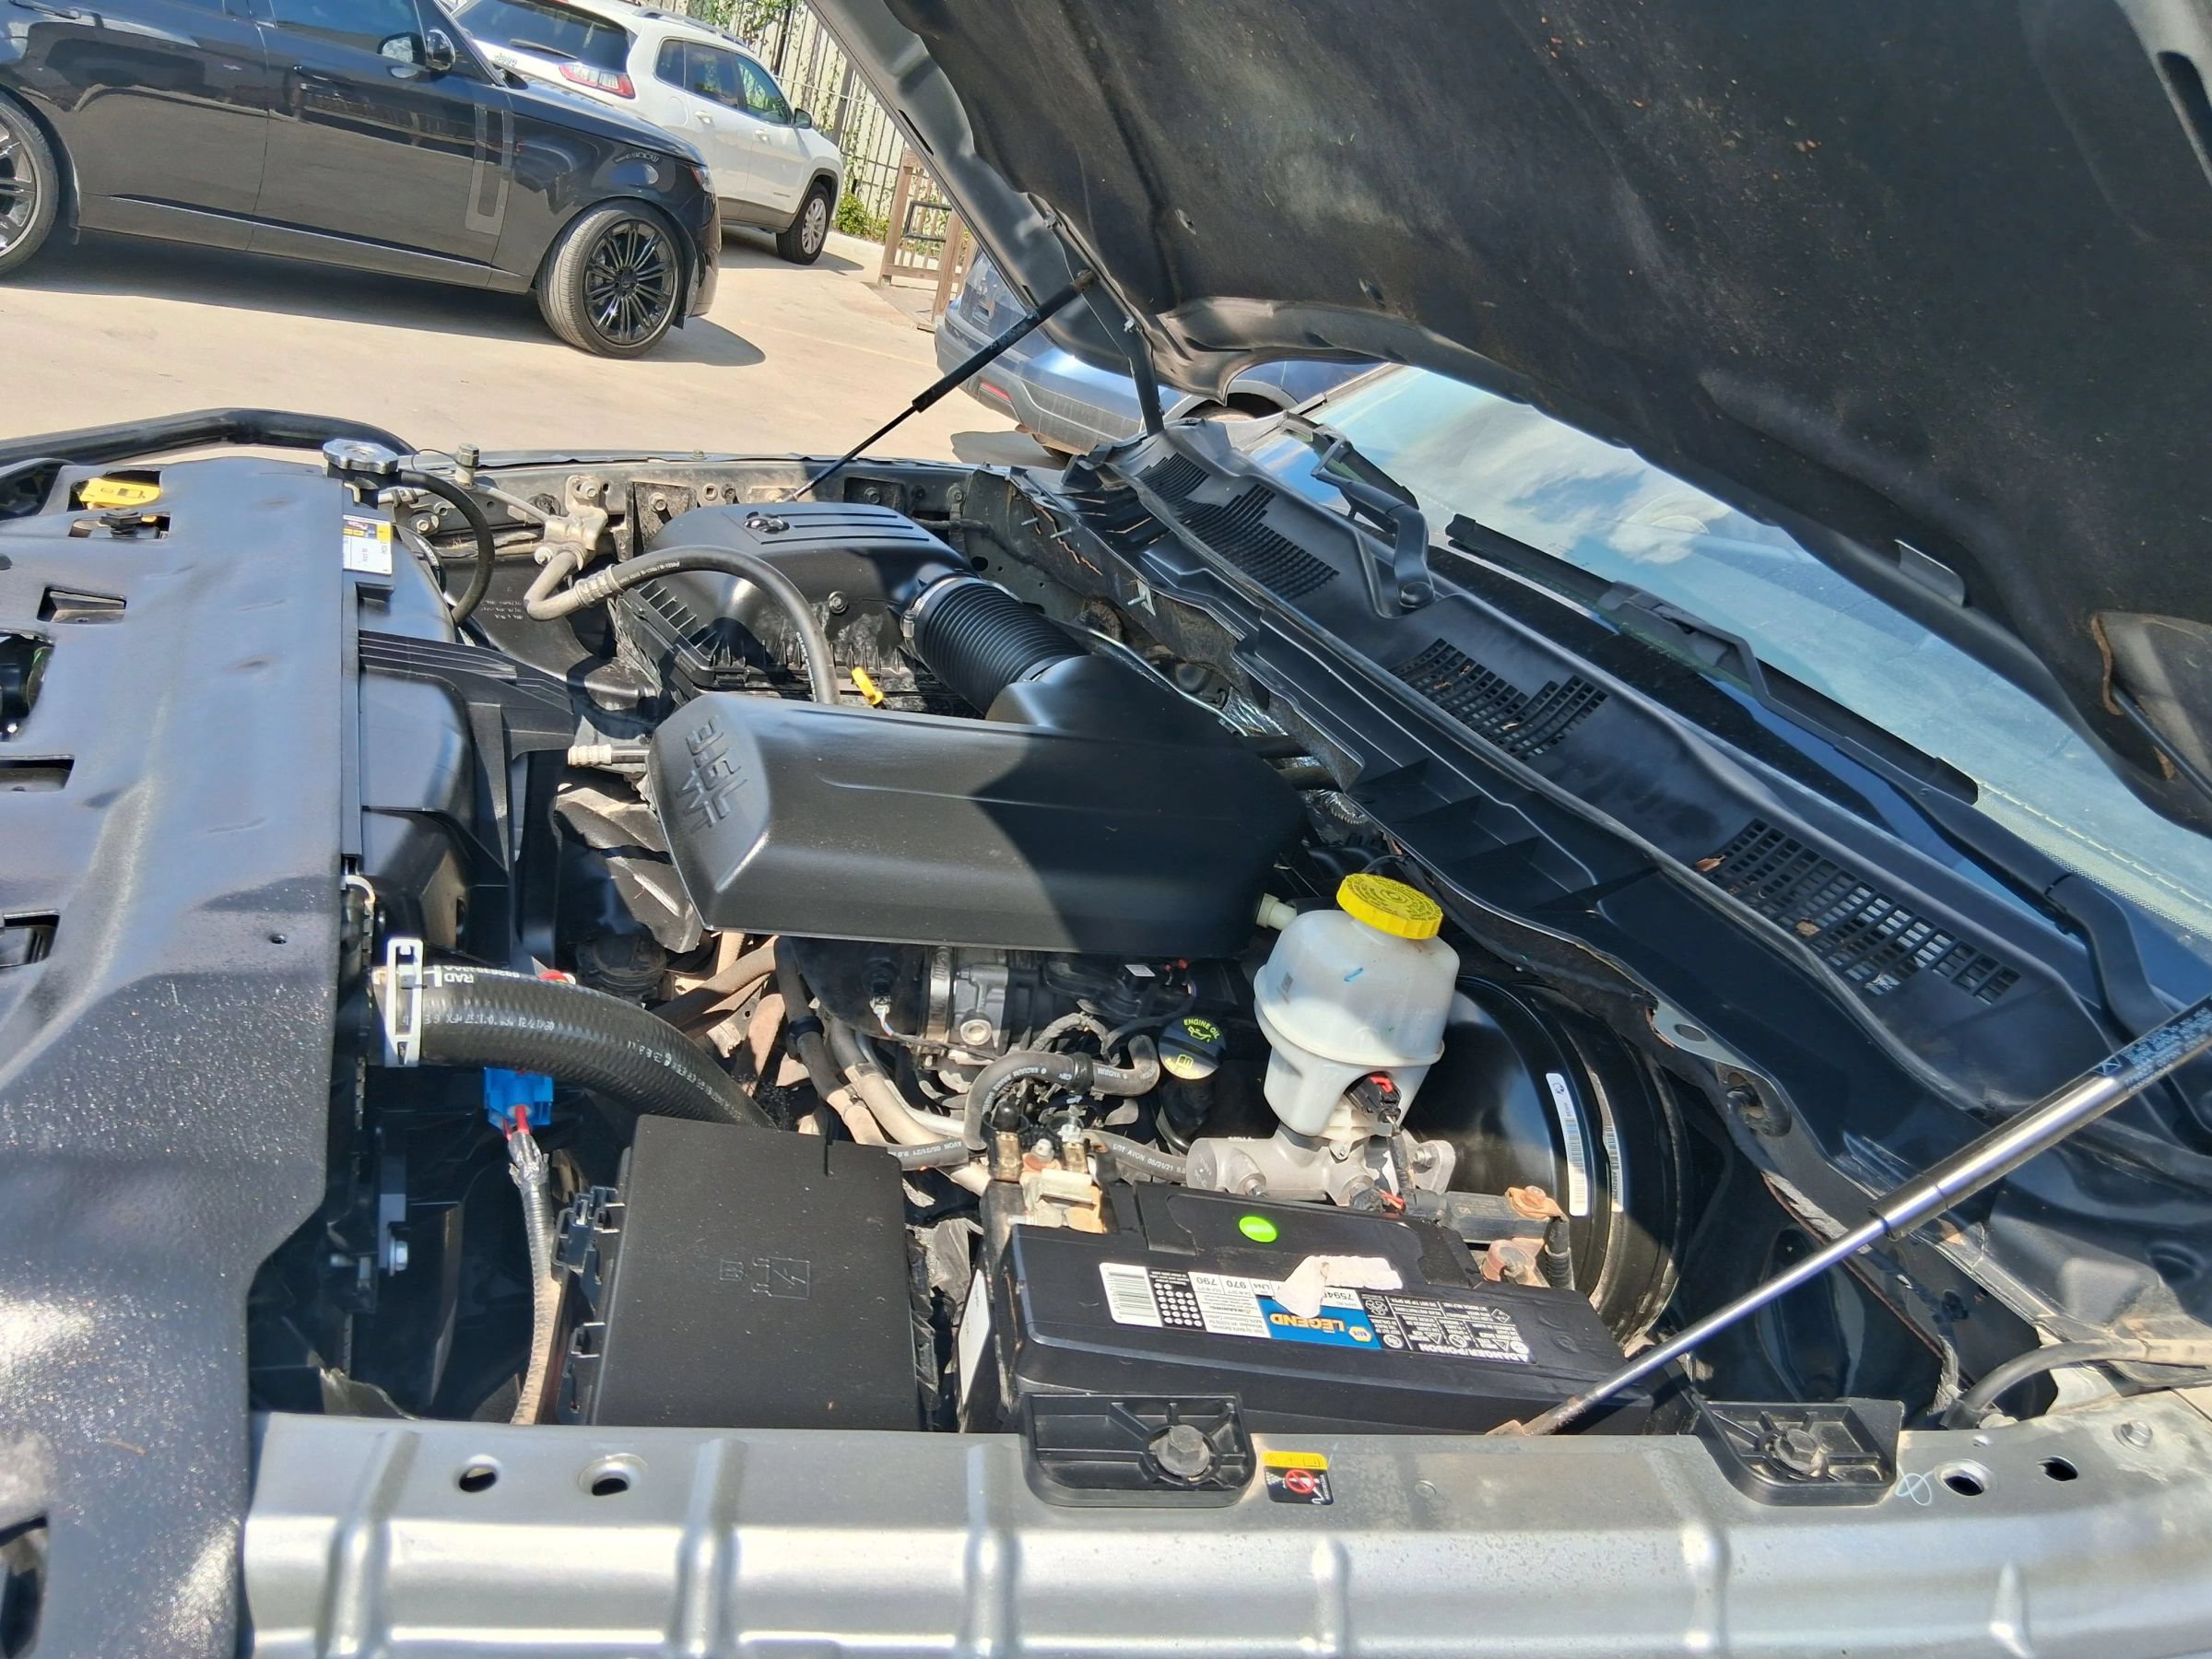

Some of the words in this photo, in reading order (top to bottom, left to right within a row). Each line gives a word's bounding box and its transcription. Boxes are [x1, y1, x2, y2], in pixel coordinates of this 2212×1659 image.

[443, 972, 475, 983] RAD
[1183, 1018, 1211, 1030] ENGINE
[1209, 1027, 1220, 1040] OIL
[1013, 1067, 1039, 1077] VACUUM
[944, 1141, 962, 1149] AVON
[1127, 1150, 1146, 1161] AVON
[1147, 1159, 1173, 1171] 05/31/21
[1195, 1276, 1218, 1286] 790
[1226, 1279, 1247, 1289] 970
[1253, 1282, 1271, 1290] LN4
[1270, 1312, 1345, 1332] LEGEND
